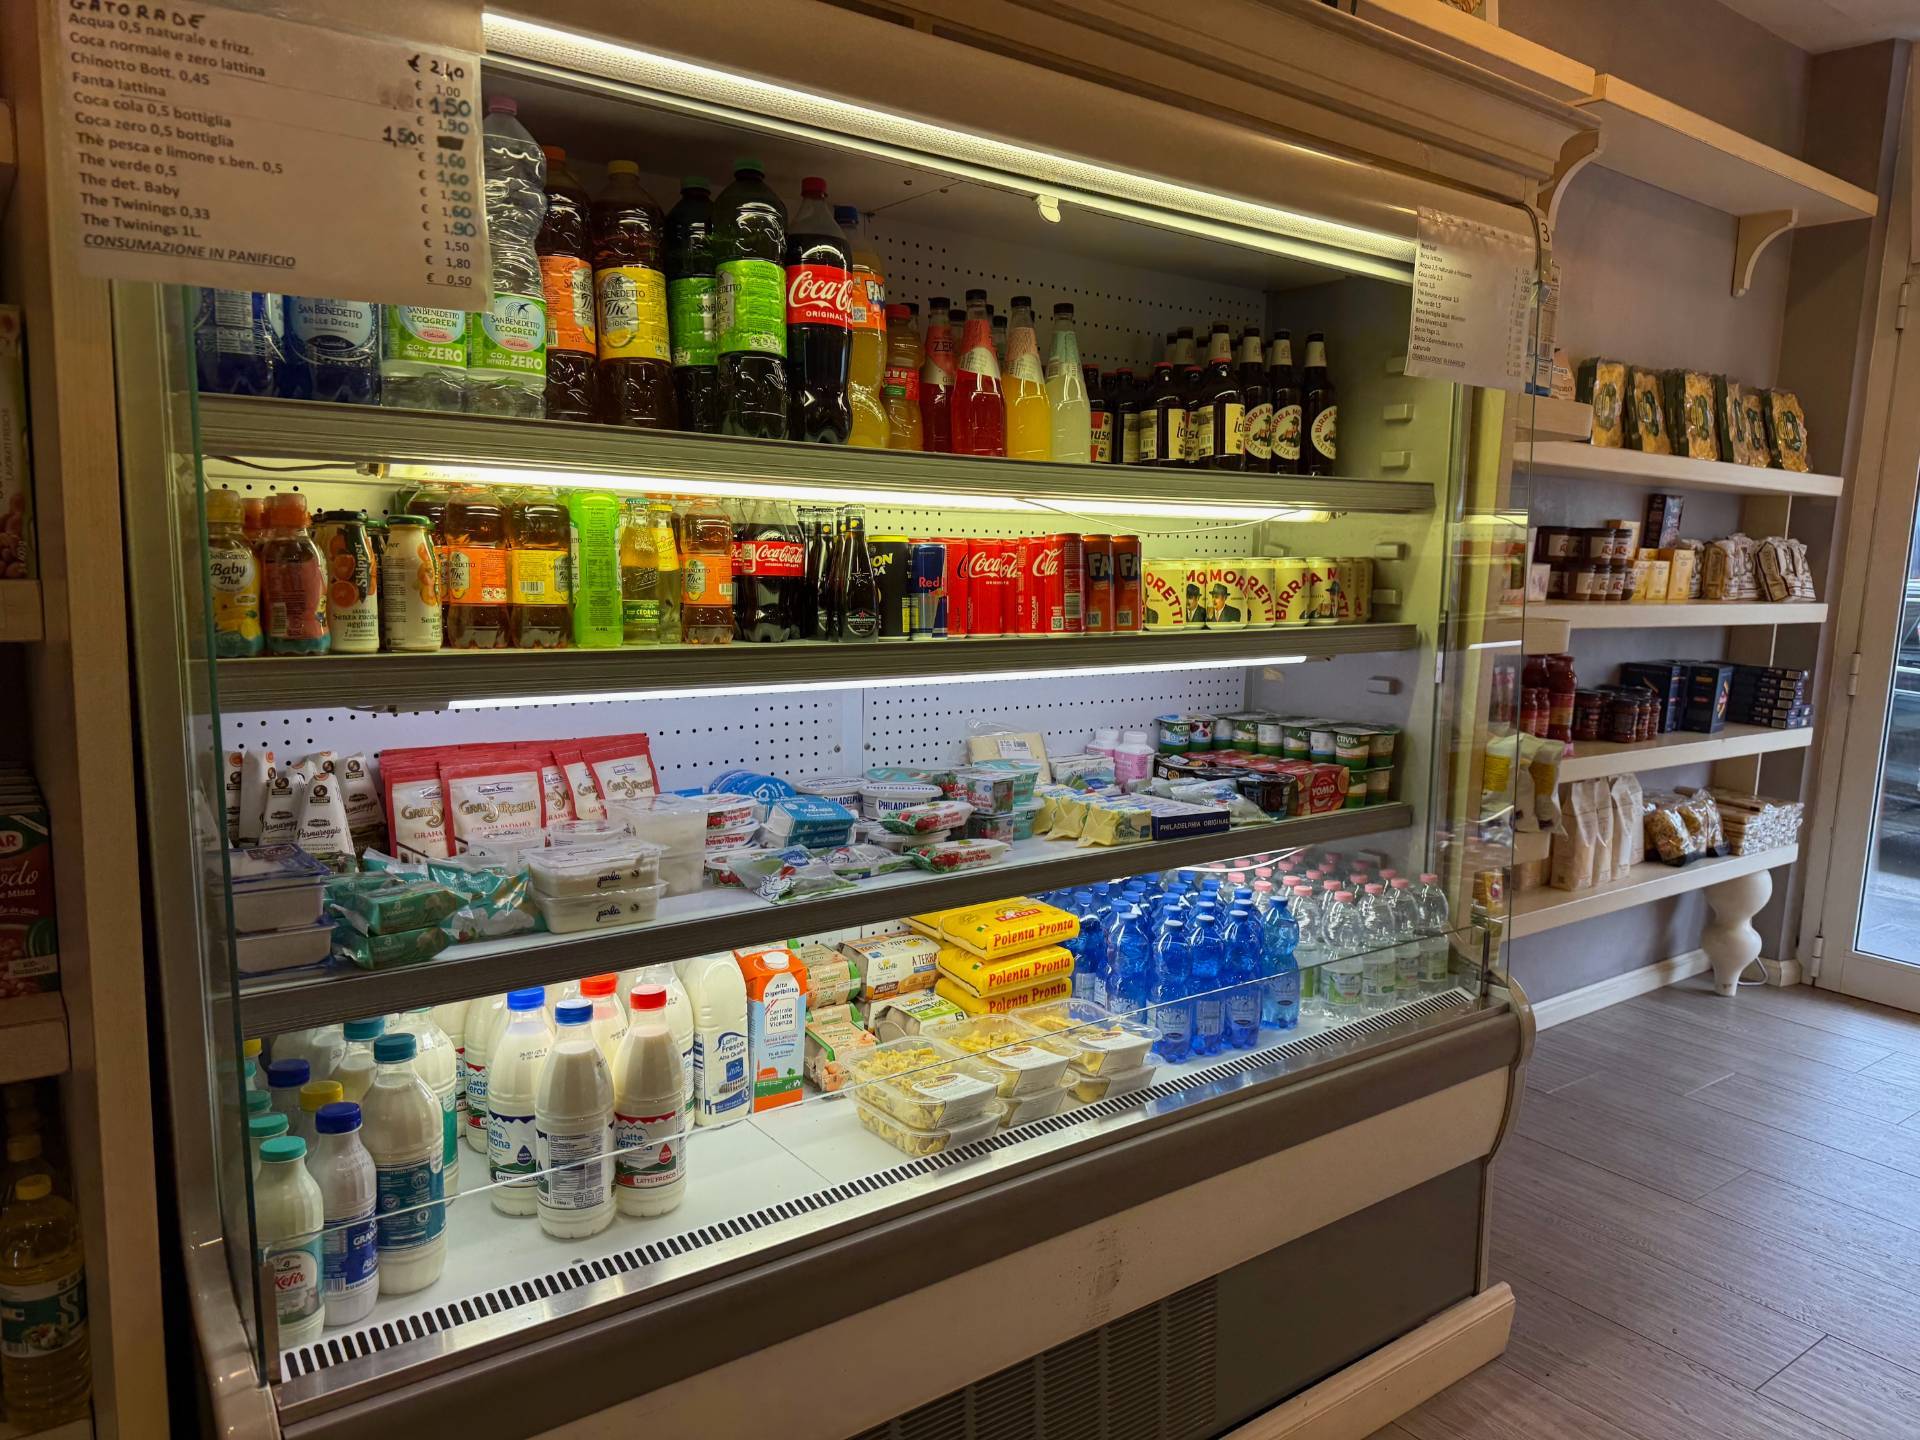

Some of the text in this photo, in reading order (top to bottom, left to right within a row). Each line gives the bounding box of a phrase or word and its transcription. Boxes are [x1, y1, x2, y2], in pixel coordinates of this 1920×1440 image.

[68, 0, 206, 28] GATORADE
[69, 13, 114, 31] Acqua
[119, 21, 141, 34] 0,5
[146, 26, 206, 46] naturale
[210, 39, 219, 49] e
[222, 40, 255, 56] frizz.
[70, 32, 105, 48] Coca
[110, 40, 170, 60] normale
[174, 52, 184, 61] e
[188, 54, 218, 68] zero
[221, 58, 266, 77] lattina
[71, 52, 136, 73] Chinotto
[140, 63, 176, 80] Bott.
[180, 70, 210, 86] 0,45
[73, 72, 114, 90] Fanta
[118, 78, 167, 97] lattina
[74, 92, 109, 108] Coca
[113, 98, 143, 114] cola
[147, 103, 170, 118] 0,5
[174, 107, 231, 128] bottiglia
[75, 112, 110, 128] Coca
[115, 120, 146, 135] zero
[150, 124, 173, 138] 0,5
[177, 127, 234, 148] bottiglia
[78, 152, 105, 167] The
[109, 158, 151, 174] verde
[155, 164, 177, 178] 0,5
[108, 141, 150, 155] pesca
[154, 146, 162, 155] e
[166, 145, 215, 164] limone
[262, 162, 283, 175] 0,5
[79, 172, 106, 187] The
[111, 177, 140, 192] det.
[145, 182, 180, 199] Baby
[80, 192, 108, 208] The
[113, 197, 176, 217] Twinings
[180, 206, 210, 220] 0,33
[445, 241, 470, 252] 1,50
[82, 212, 110, 228] The
[114, 216, 178, 237] Twinings
[446, 257, 471, 269] 1,80
[84, 233, 205, 257] CONSUMAZIONE
[209, 248, 225, 260] IN
[228, 249, 296, 268] PANIFICIO
[447, 275, 472, 287] 0,50
[411, 315, 457, 328] ECOGREEN
[806, 310, 843, 321] ORIGINAL
[495, 325, 538, 337] ECOGREEN
[427, 347, 463, 363] ZERO
[511, 355, 543, 370] ZERO
[354, 542, 368, 588] Skipper
[756, 544, 803, 563] Coca-Cola
[210, 562, 246, 578] Baby
[919, 577, 940, 588] Red
[1160, 820, 1201, 832] PHILADELPHIA
[993, 919, 1074, 947] Polenta Pronta
[989, 957, 1070, 987] Polenta Pronta
[989, 982, 1067, 1013] Polenta Pronta
[769, 1007, 793, 1016] Centrale
[769, 1019, 793, 1028] Vicenza
[780, 1013, 793, 1021] latte
[722, 1041, 744, 1054] Fresco
[620, 1132, 644, 1142] Latte
[655, 1171, 677, 1183] FRESCO
